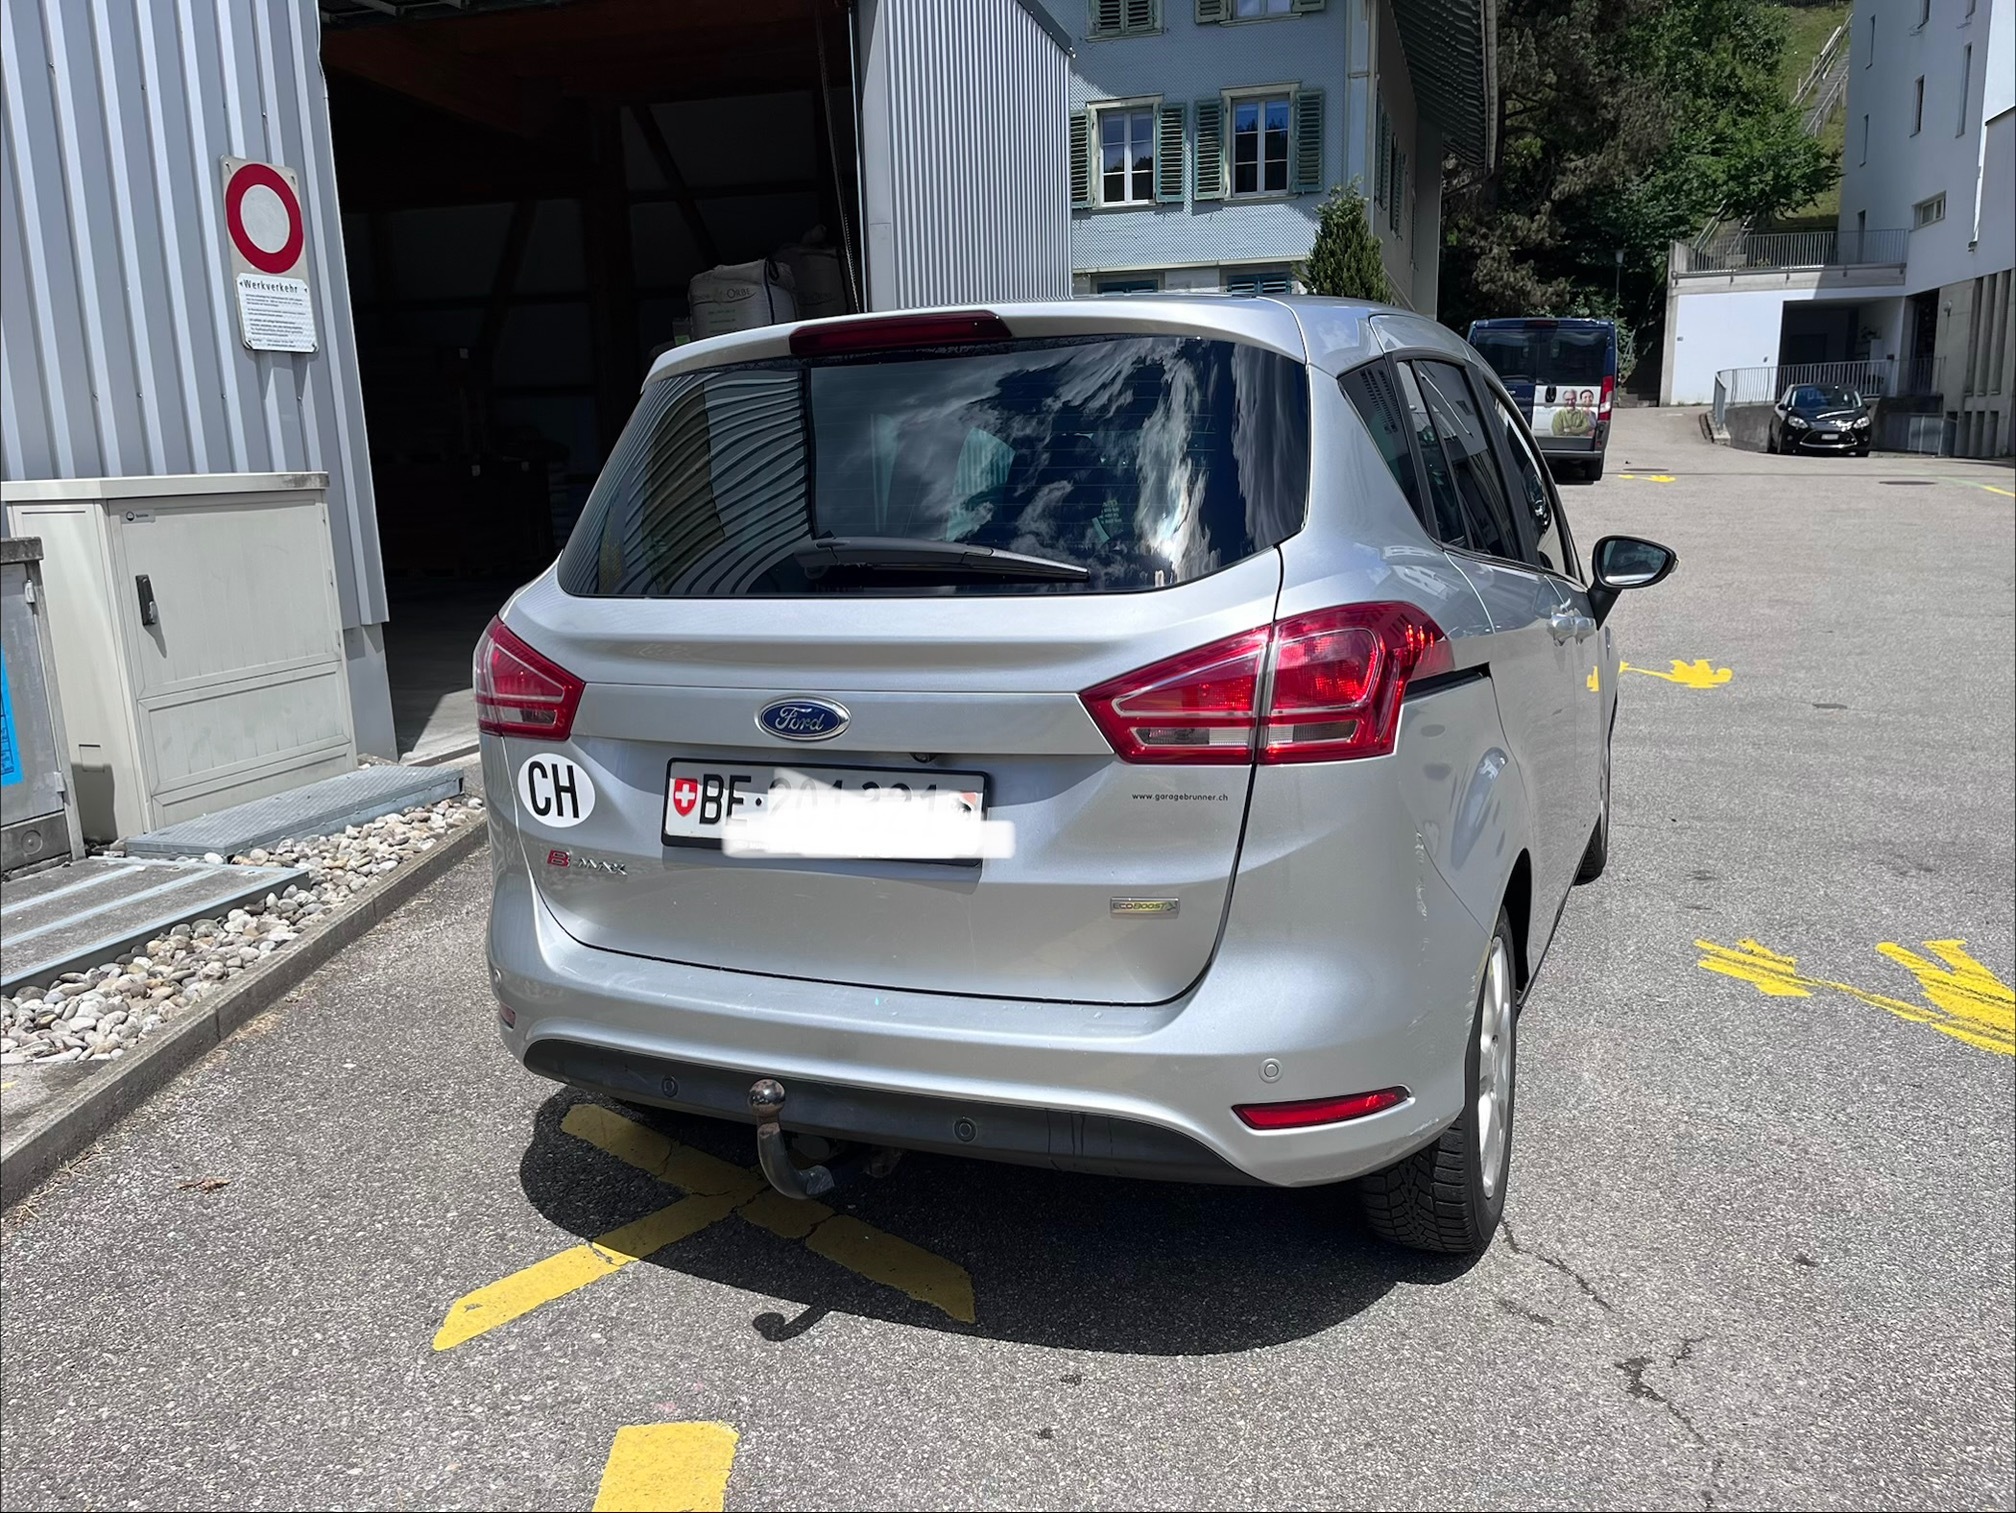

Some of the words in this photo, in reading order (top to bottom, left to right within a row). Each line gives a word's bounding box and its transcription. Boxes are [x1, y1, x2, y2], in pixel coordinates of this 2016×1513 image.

[243, 279, 298, 293] Werkverkehr
[774, 706, 825, 732] Ford
[528, 760, 580, 818] CH
[1131, 793, 1229, 801] www.garagebrunner.ch
